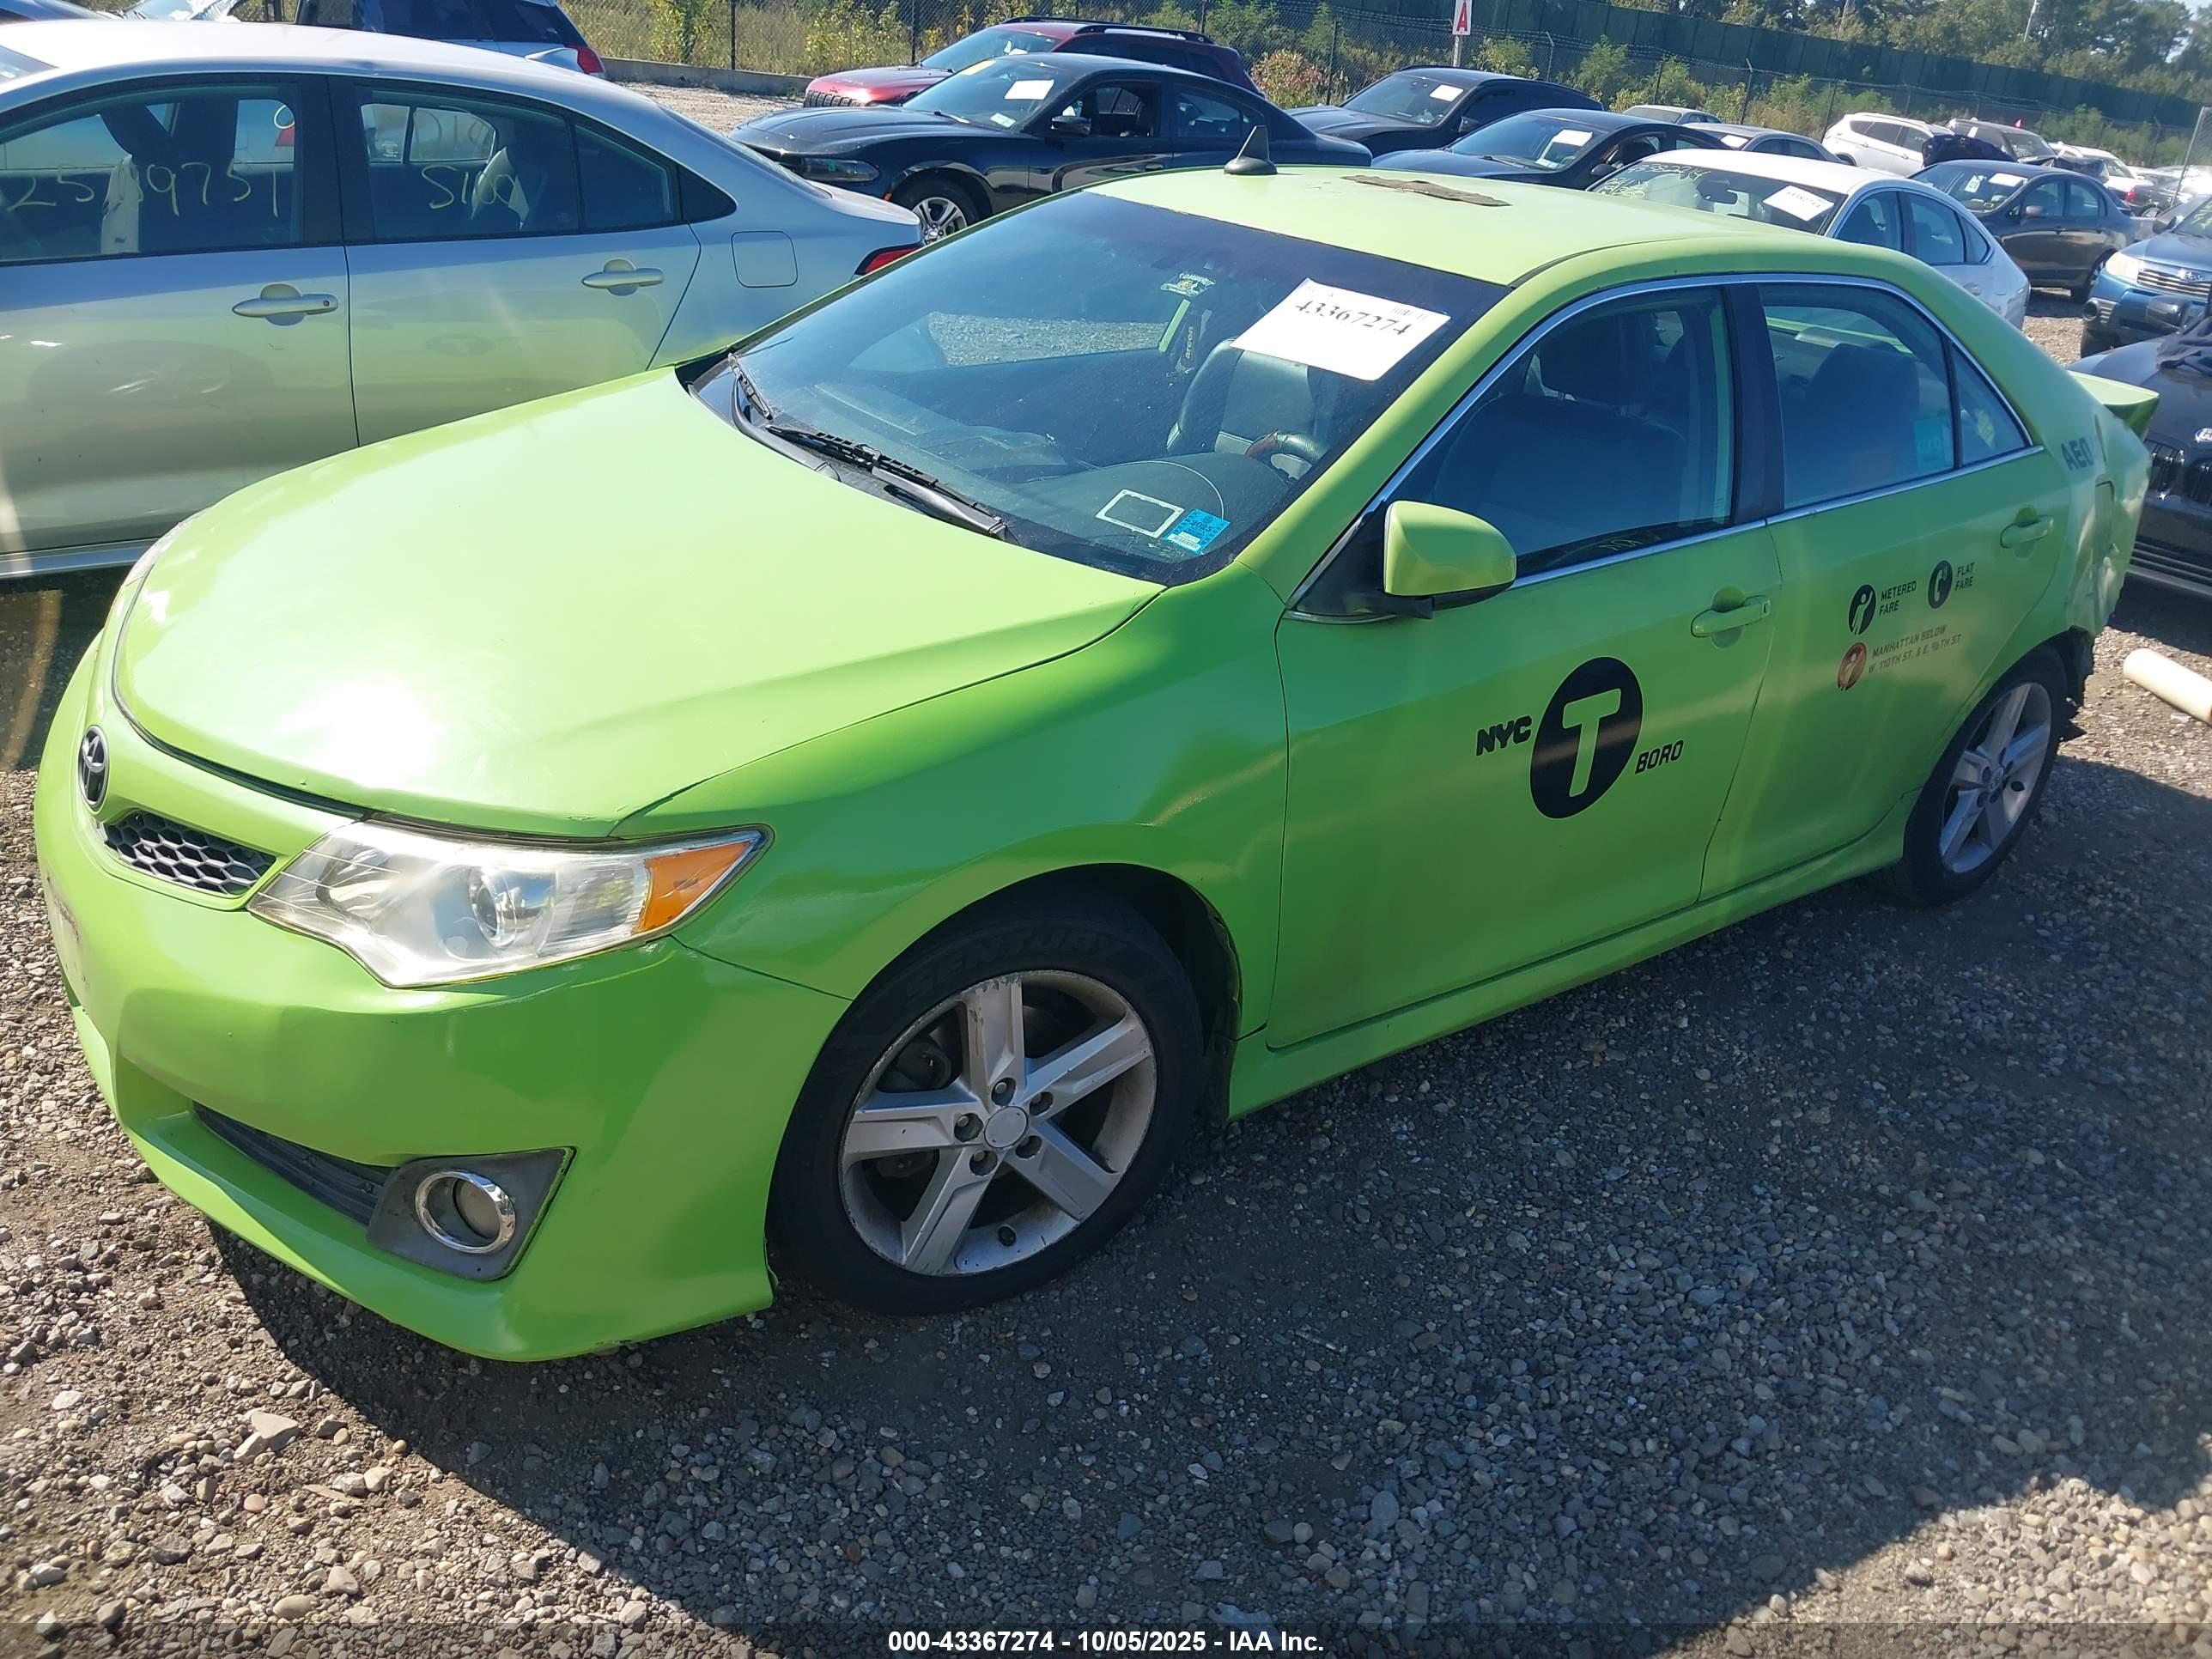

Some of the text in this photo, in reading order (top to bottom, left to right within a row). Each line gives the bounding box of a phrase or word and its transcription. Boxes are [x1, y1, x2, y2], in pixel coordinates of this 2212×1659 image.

[1455, 0, 1468, 32] A
[1295, 301, 1412, 336] 43367274
[1955, 576, 1973, 591] FARE
[1957, 562, 1975, 578] FLAT
[1881, 580, 1917, 602] METERED
[1879, 600, 1899, 616] FARE
[1872, 625, 1947, 658] MANHATTAN BELOW
[1476, 715, 1532, 756] NYC
[1562, 688, 1622, 798] T
[1635, 739, 1684, 775] BORO
